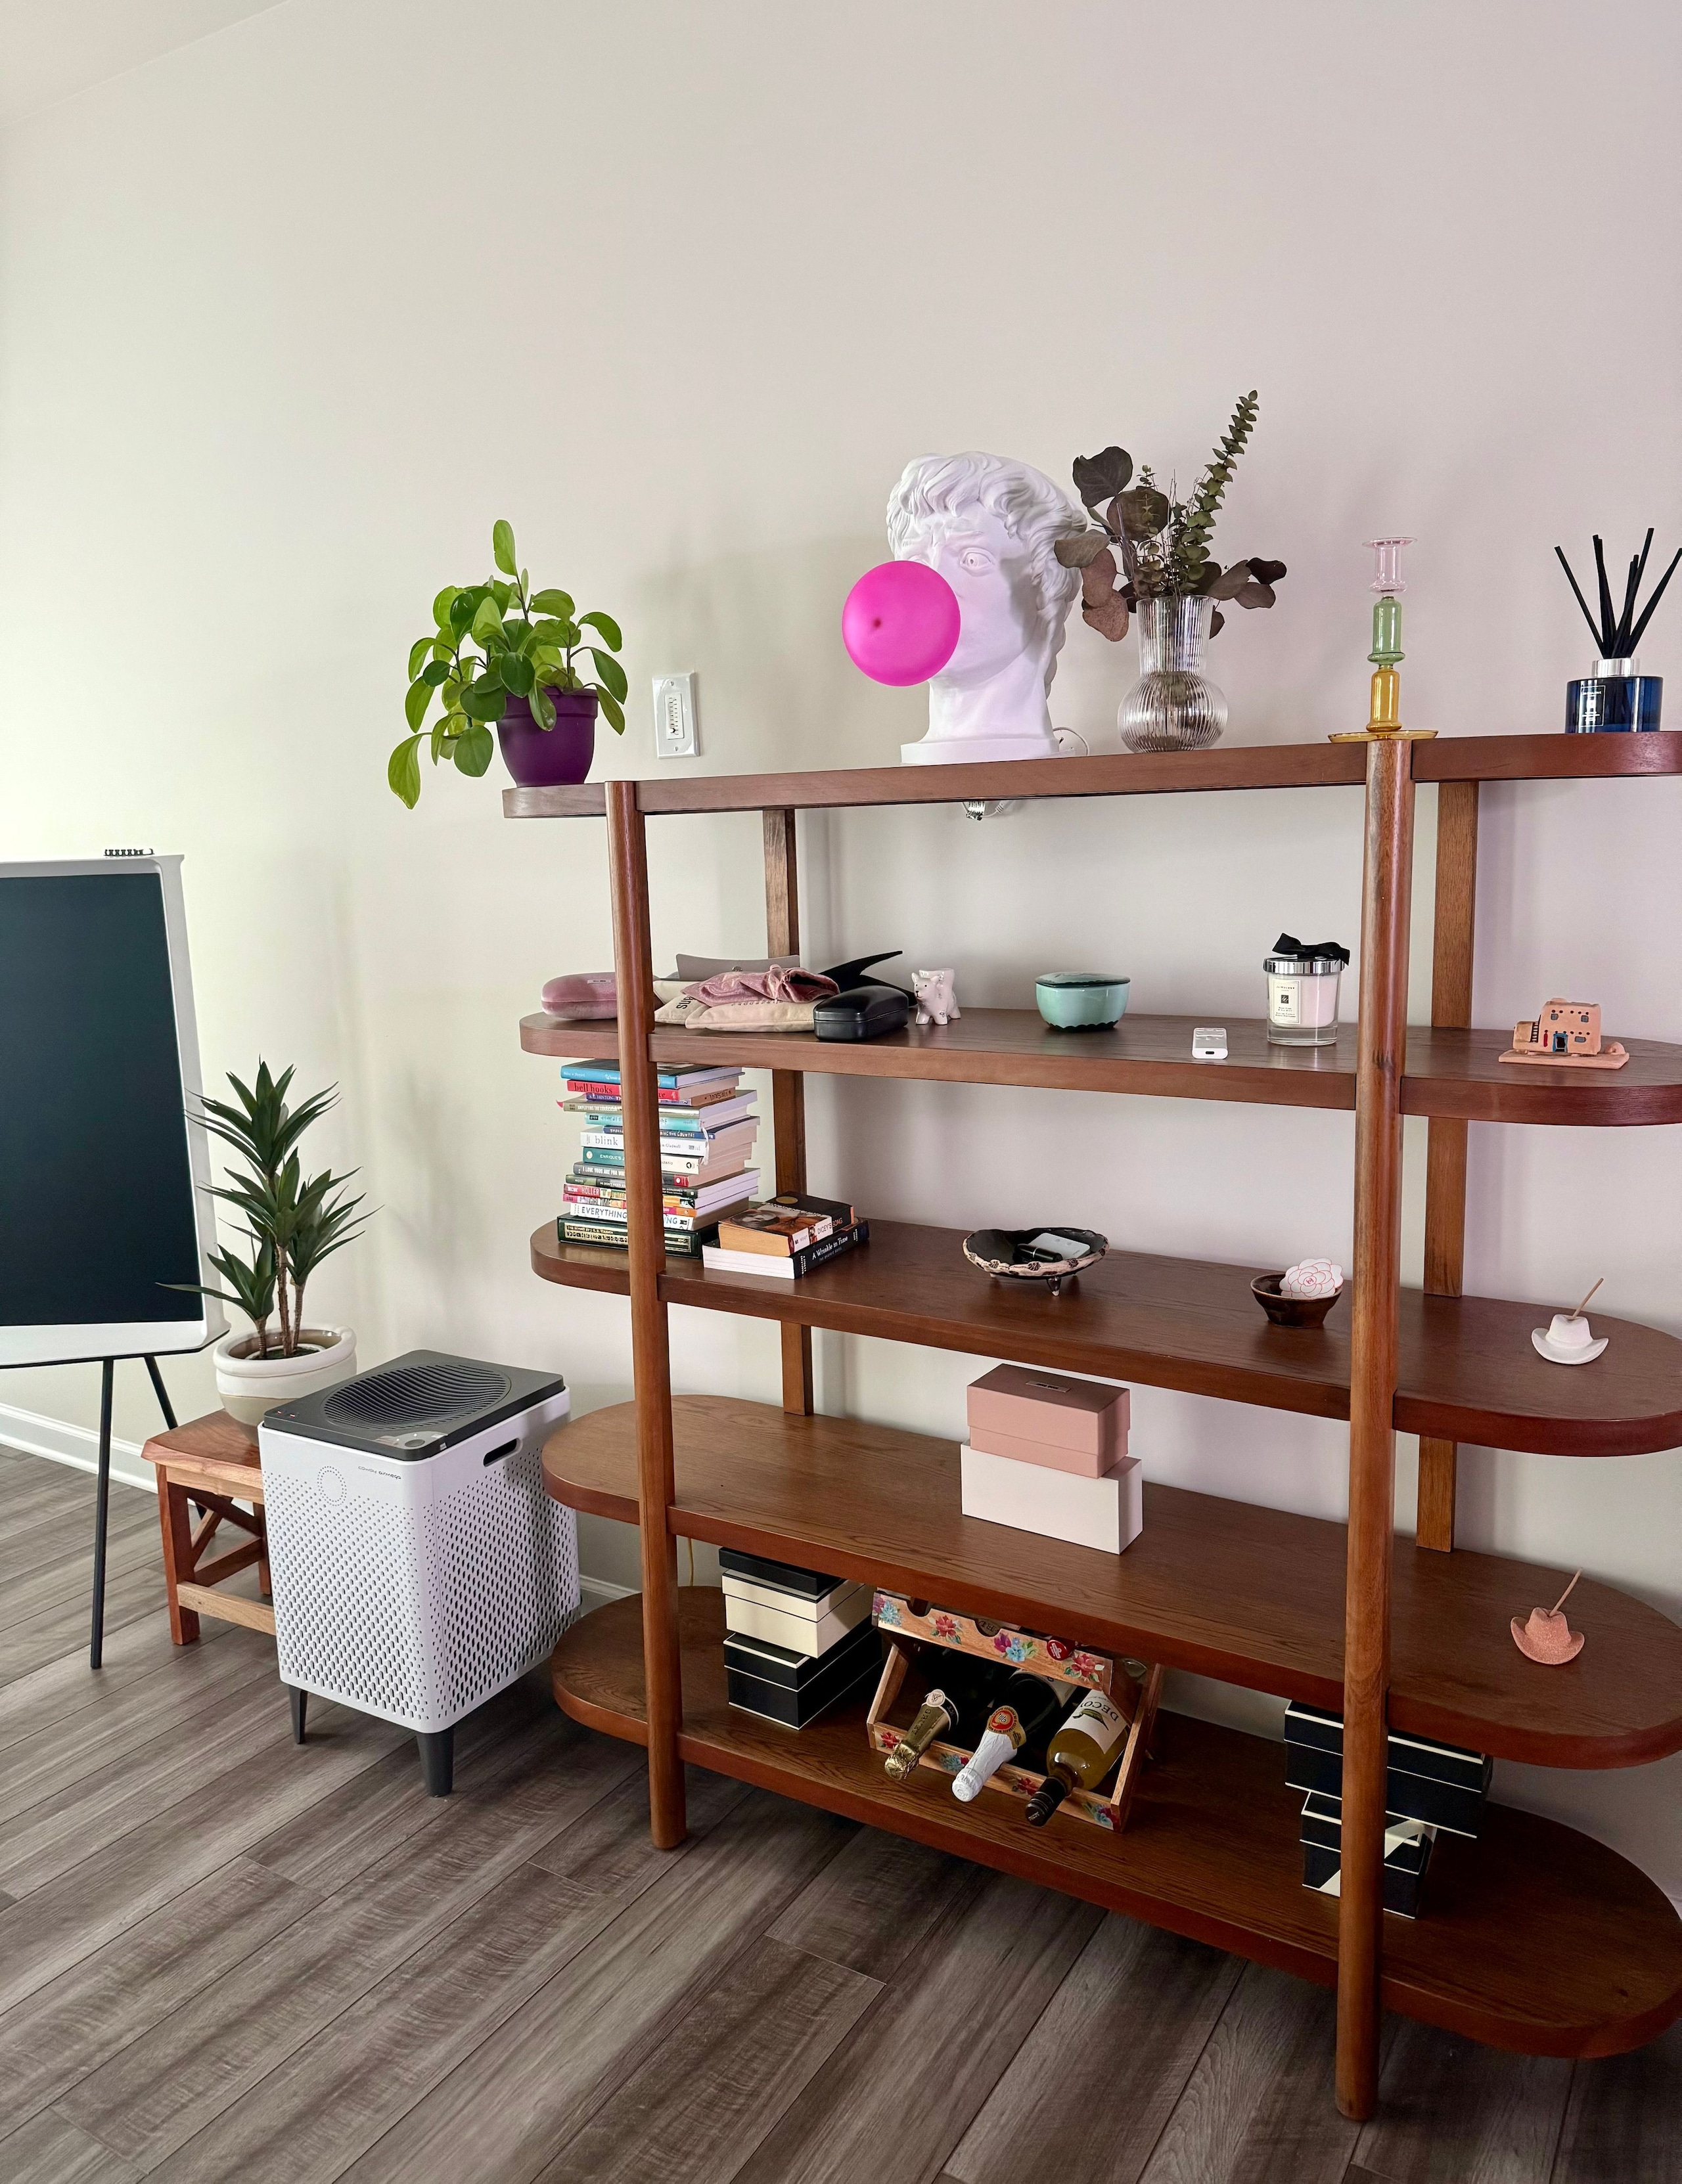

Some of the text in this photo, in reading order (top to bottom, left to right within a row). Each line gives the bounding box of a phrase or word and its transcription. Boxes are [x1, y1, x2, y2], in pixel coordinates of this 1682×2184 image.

[574, 1082, 612, 1094] bell hooks
[595, 1136, 618, 1146] blink
[581, 1187, 599, 1195] HOLLER
[600, 1198, 610, 1207] TIME
[581, 1207, 627, 1218] EVERYTHING
[817, 1217, 843, 1234] DICEY'S SONG
[816, 1243, 832, 1257] Wrinkle
[838, 1236, 848, 1245] Time
